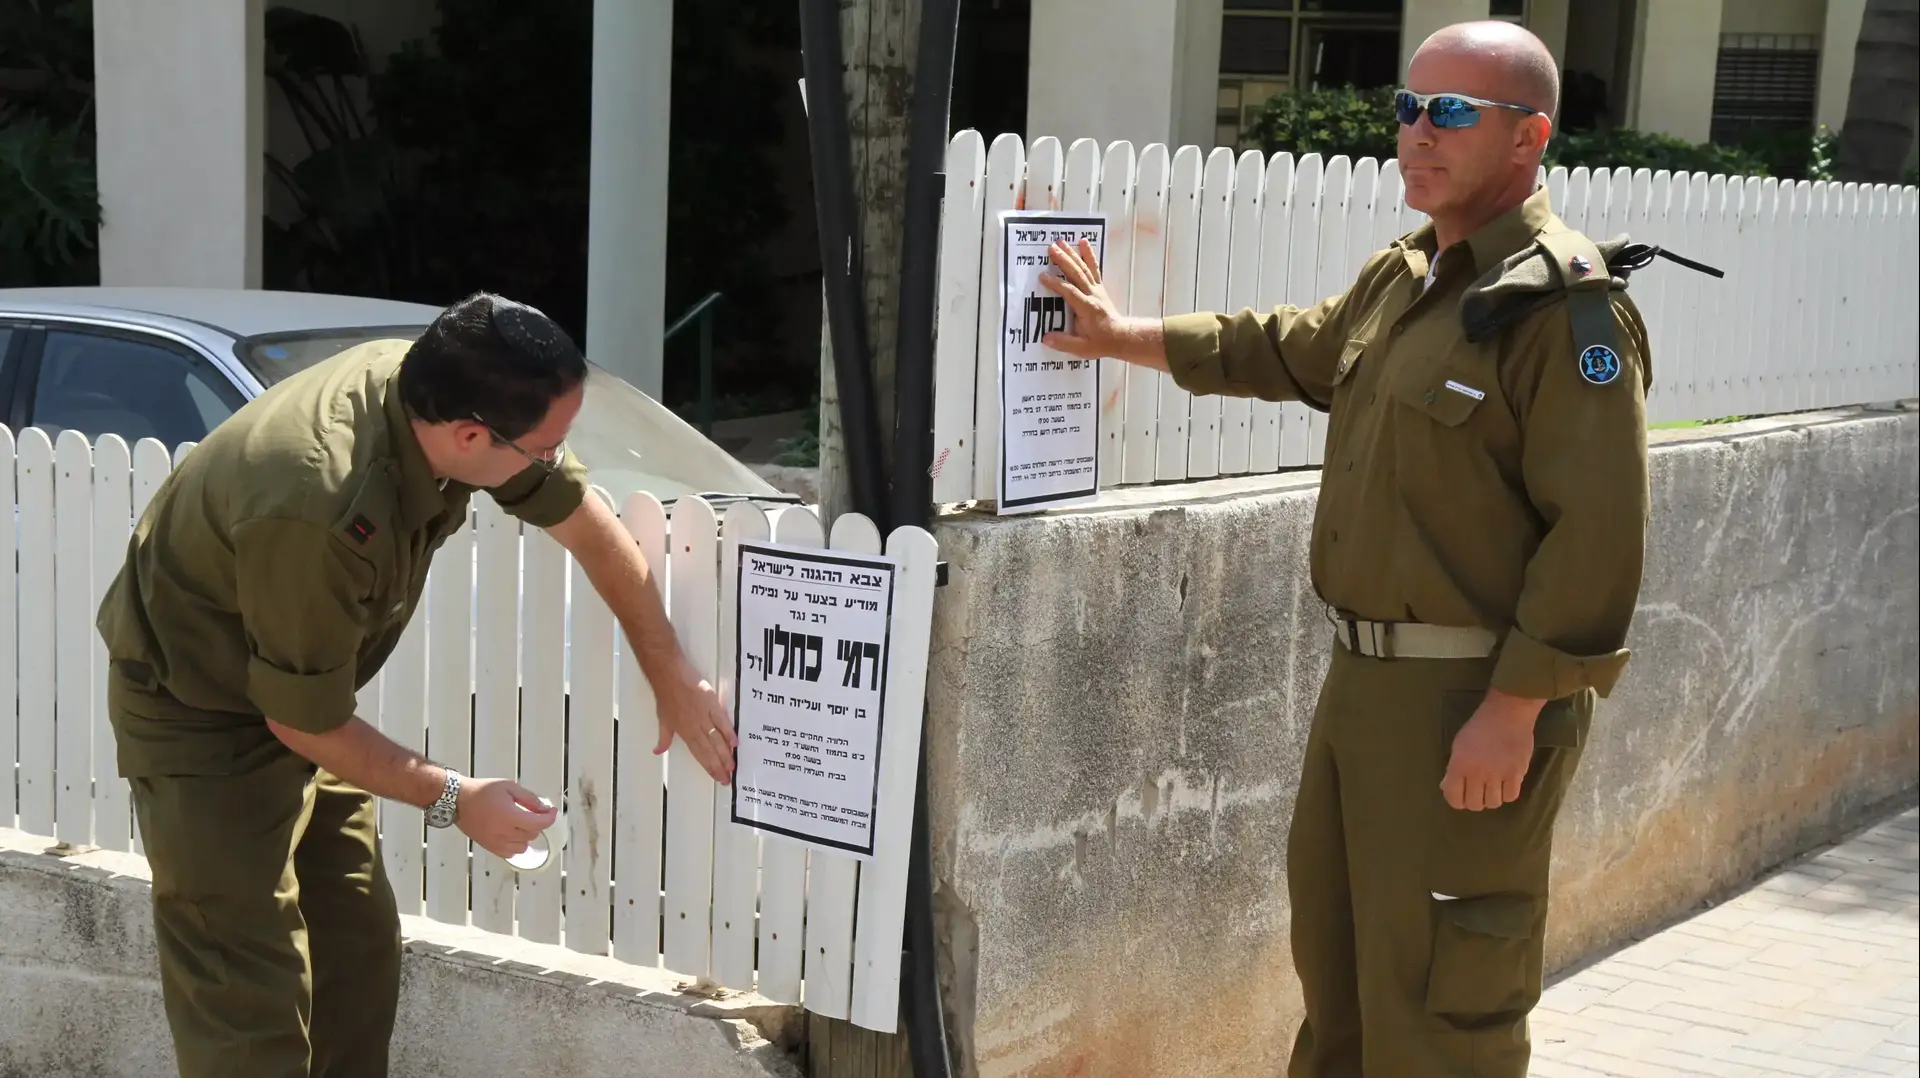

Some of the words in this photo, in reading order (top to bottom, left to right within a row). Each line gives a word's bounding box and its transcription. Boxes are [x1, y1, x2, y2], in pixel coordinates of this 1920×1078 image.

[1016, 230, 1046, 242] לישראל
[1016, 255, 1034, 265] נפילת
[1038, 255, 1049, 265] על
[1025, 362, 1037, 371] חנה
[751, 559, 794, 576] לישראל
[801, 567, 842, 583] ההגנה
[850, 573, 882, 587] צבא
[751, 584, 778, 598] נפילת
[784, 589, 798, 601] על
[805, 593, 837, 606] בצער
[844, 598, 878, 611] מודיע
[790, 610, 806, 621] נגד
[811, 613, 826, 624] רב
[763, 624, 823, 682] כחלון
[837, 639, 880, 691] רמי
[767, 693, 784, 705] חנה
[789, 697, 821, 711] ועליזה
[827, 703, 848, 715] יוסף
[854, 708, 866, 719] בן
[762, 724, 781, 734] ראשון
[784, 729, 797, 738] ביום
[748, 732, 762, 741] 2014
[826, 749, 848, 759] בתמוז
[763, 758, 785, 768] בחדרה
[804, 756, 821, 766] בשעה
[828, 772, 846, 781] בבית
